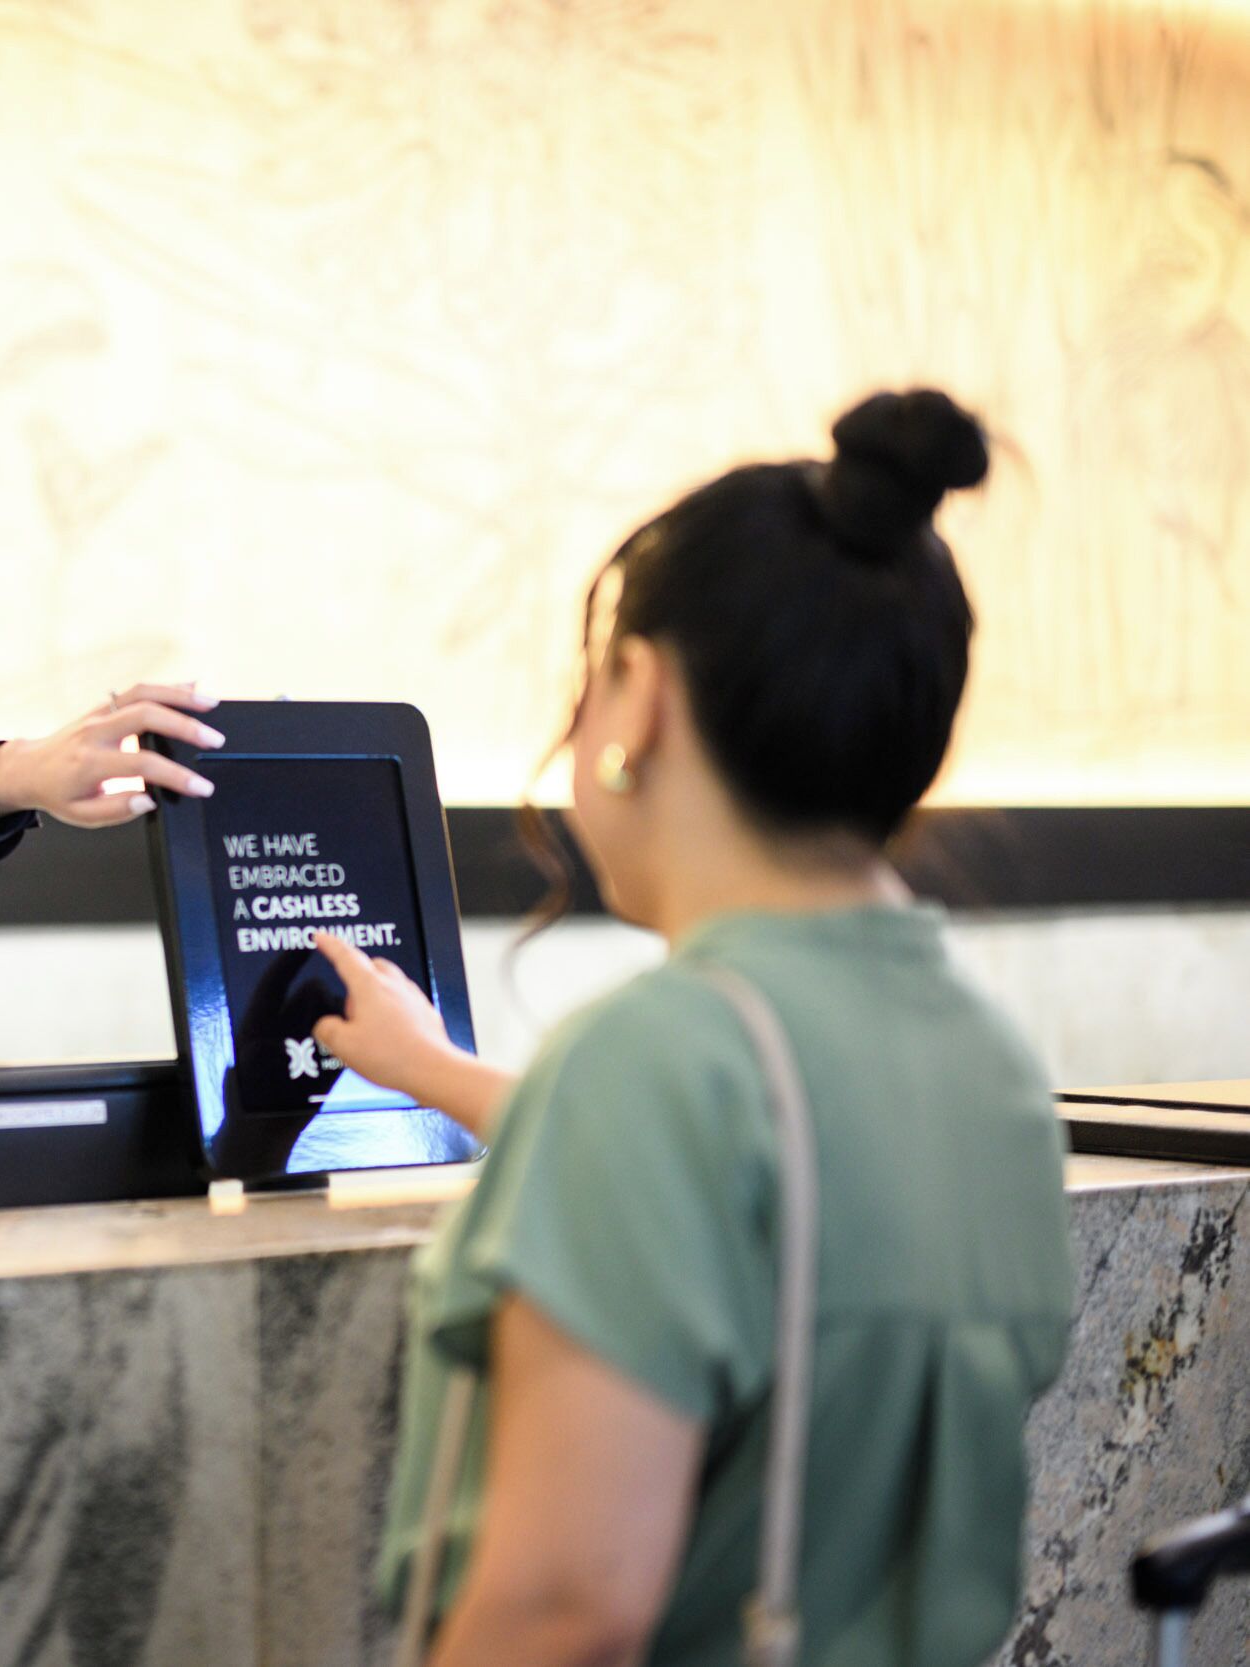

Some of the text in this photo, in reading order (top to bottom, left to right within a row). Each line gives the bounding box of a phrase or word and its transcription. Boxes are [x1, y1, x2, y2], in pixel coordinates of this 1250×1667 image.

[223, 833, 319, 858] WE HAVE
[228, 863, 345, 890] EMBRACED
[233, 893, 360, 921] A CASHLESS
